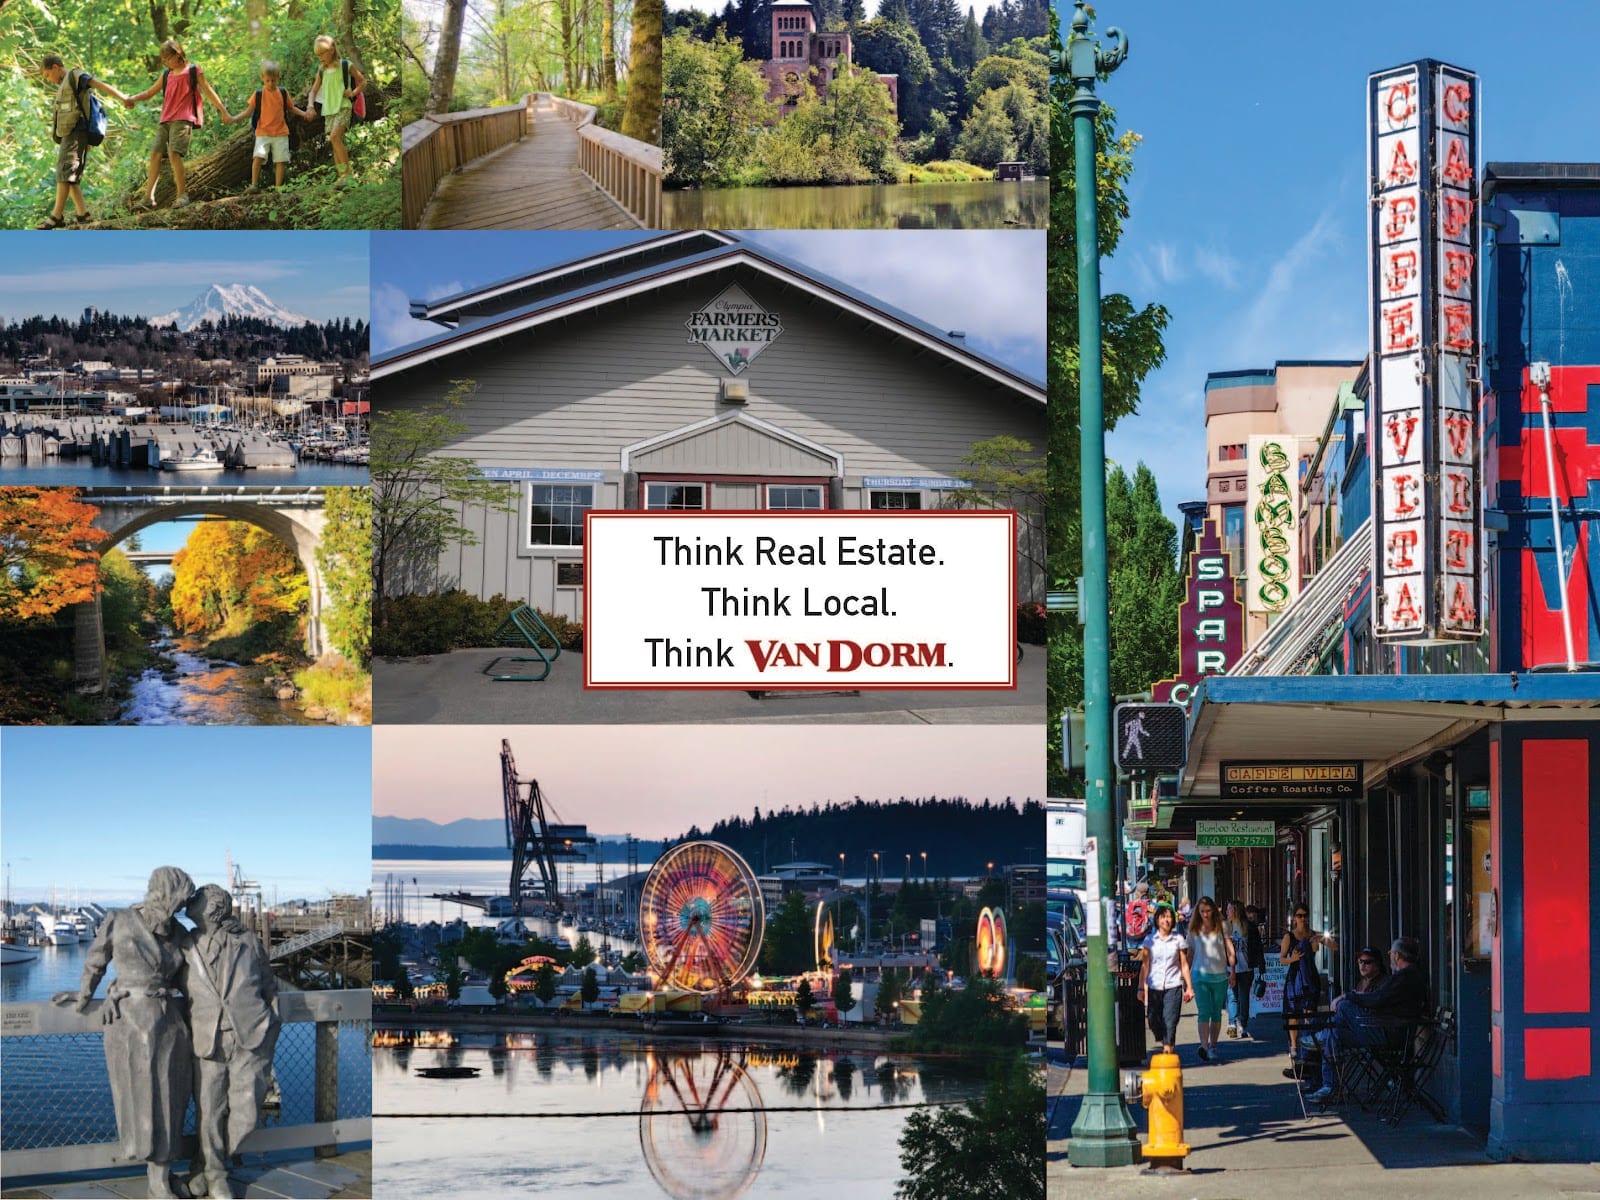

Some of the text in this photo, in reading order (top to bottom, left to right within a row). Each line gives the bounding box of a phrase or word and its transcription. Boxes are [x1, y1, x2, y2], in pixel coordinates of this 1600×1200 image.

[715, 300, 753, 312] Olympia
[690, 312, 780, 327] FARMERS
[690, 328, 777, 342] MARKET
[502, 470, 533, 479] APRIL
[542, 471, 601, 480] DECEMBER
[865, 478, 912, 488] THURSDAY
[919, 479, 952, 489] SUNDAY
[1255, 442, 1294, 608] BAMBOO
[1385, 415, 1418, 622] VITA
[1444, 415, 1476, 622] VITA
[1195, 558, 1226, 674] SPAR
[1305, 767, 1354, 779] VITA
[1230, 784, 1353, 794] Coffee Roasting Co.
[1199, 822, 1273, 833] Bamboo Restaurant
